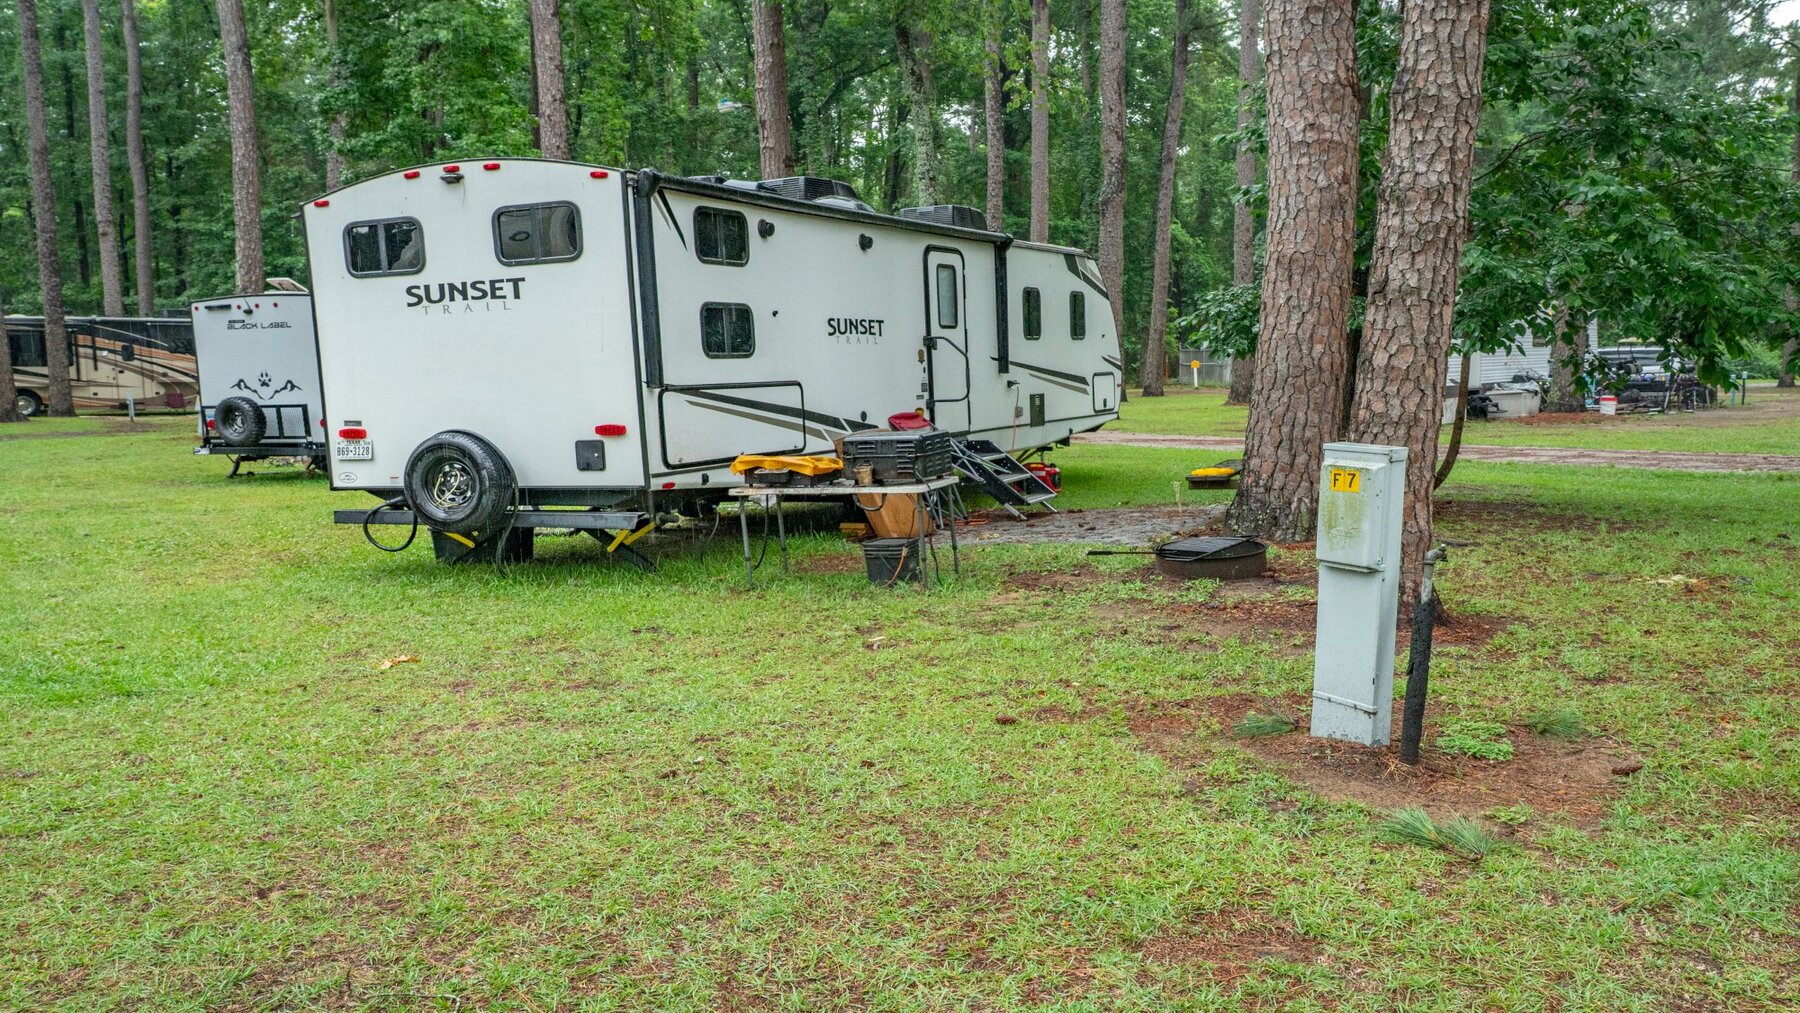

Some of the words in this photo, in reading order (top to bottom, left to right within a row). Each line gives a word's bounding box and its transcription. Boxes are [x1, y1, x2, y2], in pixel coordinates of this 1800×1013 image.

[405, 277, 526, 307] SUNSET
[422, 300, 511, 316] TRAIL
[260, 321, 292, 329] LABEL
[827, 317, 884, 337] SUNSET
[835, 335, 879, 345] TRAIL
